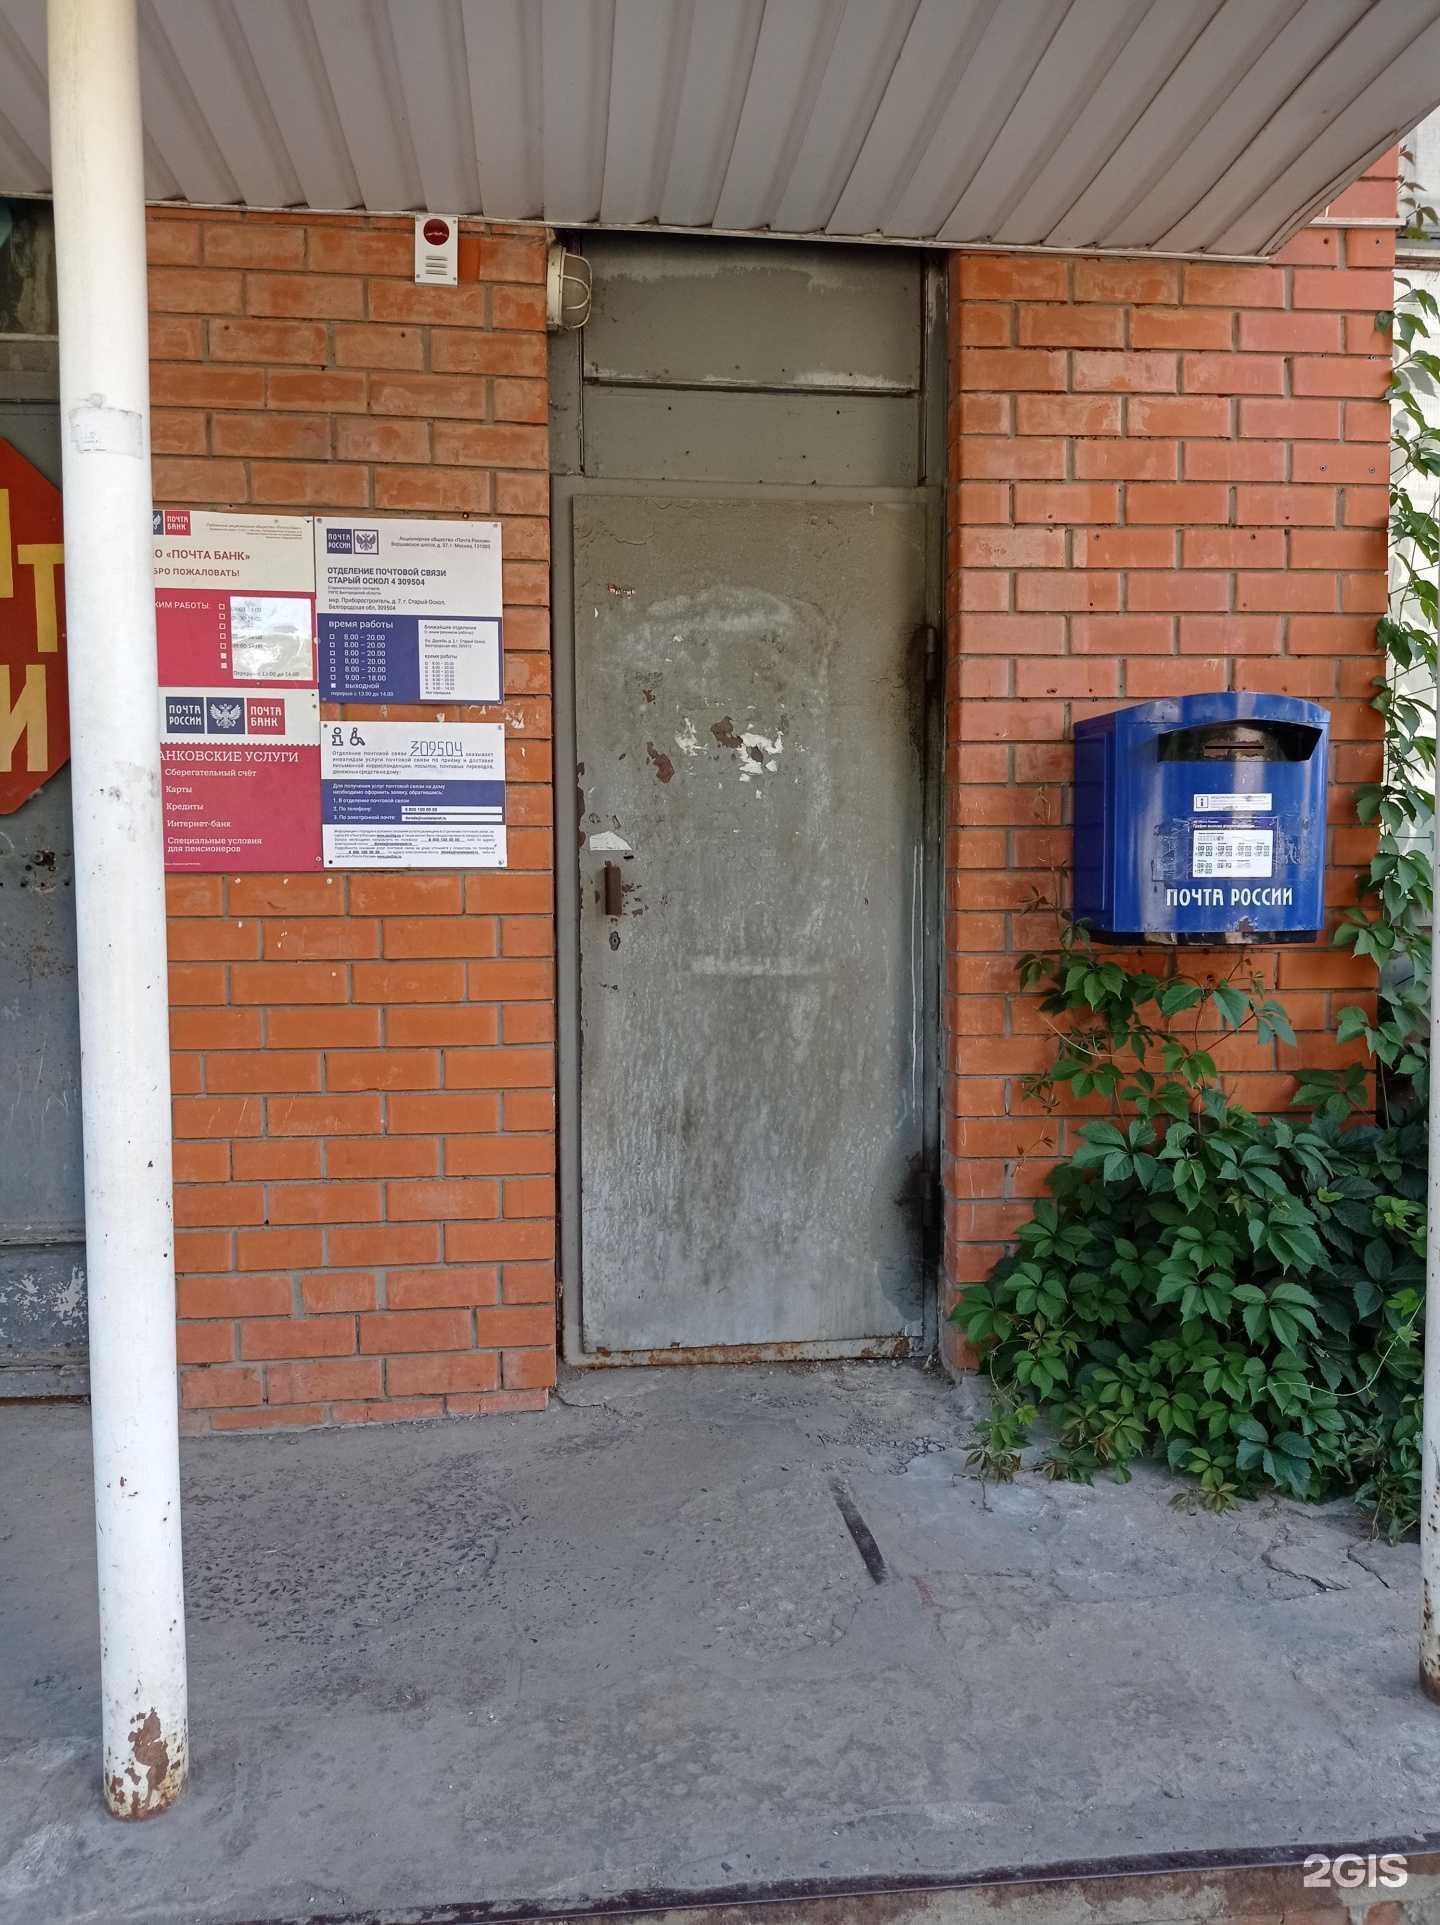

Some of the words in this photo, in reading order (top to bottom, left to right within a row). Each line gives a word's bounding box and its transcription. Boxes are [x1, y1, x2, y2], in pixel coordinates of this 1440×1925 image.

[166, 550, 212, 560] «ПОЧТА
[214, 551, 250, 561] БАНК»
[172, 568, 240, 577] ПОЖАЛОВАТЬ!
[328, 567, 374, 576] ОТДЕЛЕНИЕ
[376, 567, 419, 576] ПОЧТОВОЙ
[328, 576, 361, 584] СТАРЫЙ
[329, 621, 358, 629] время
[360, 620, 393, 629] работы
[169, 705, 201, 714] ПОЧТА
[250, 706, 282, 715] ПОЧТА
[169, 716, 202, 726] РОССИИ
[251, 717, 278, 727] БАНК
[245, 751, 299, 762] УСЛУГИ
[165, 768, 236, 777] Сберегательный
[166, 786, 192, 794] Карты
[166, 803, 204, 812] Кредиты
[167, 820, 231, 828] Интернет-банк
[168, 836, 226, 845] Специальные
[184, 846, 241, 854] пенсионеров
[1166, 888, 1224, 906] ПОЧТА
[1231, 888, 1293, 906] РОССИИ
